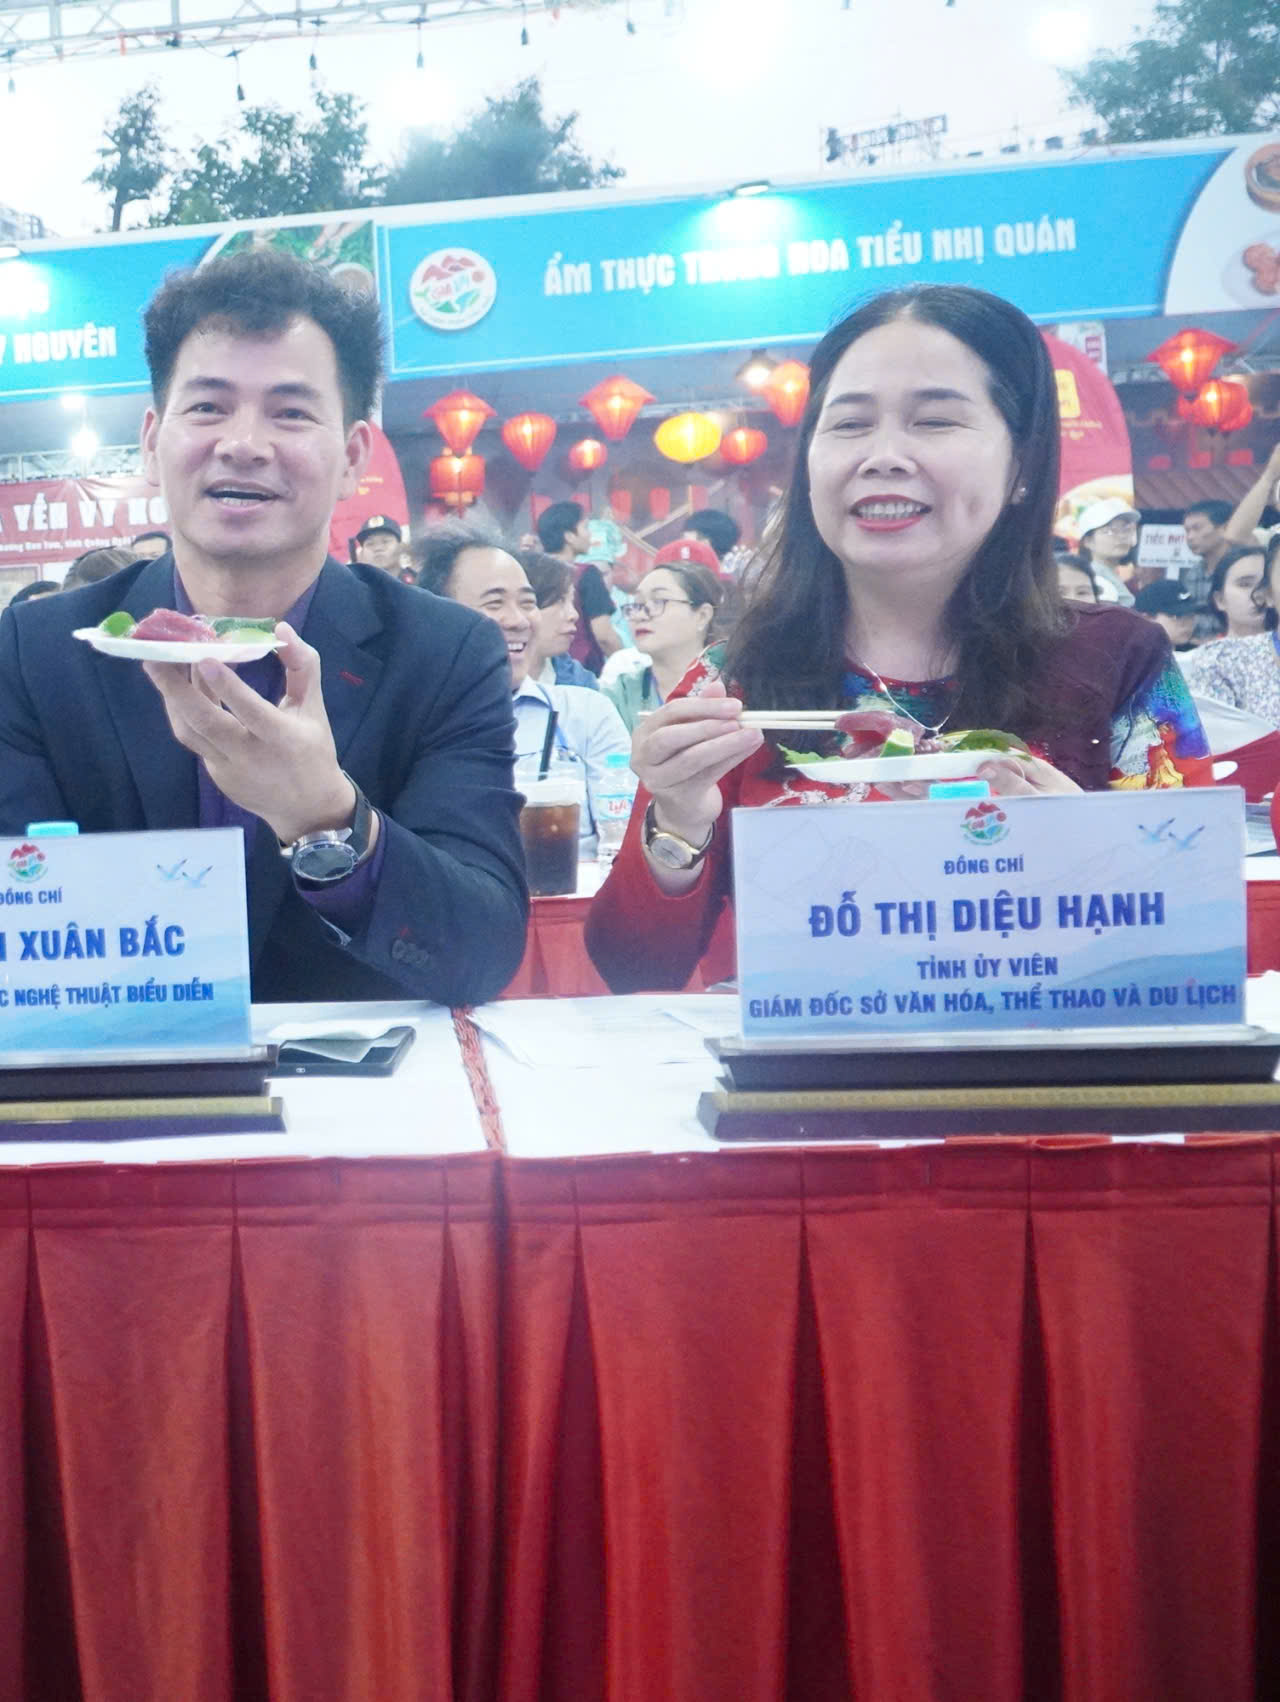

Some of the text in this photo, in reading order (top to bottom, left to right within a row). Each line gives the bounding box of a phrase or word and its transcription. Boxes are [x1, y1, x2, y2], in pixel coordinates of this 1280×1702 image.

[600, 250, 678, 296] THỰC
[857, 219, 922, 269] TIỂU
[931, 226, 985, 265] NHỊ
[12, 321, 117, 363] NGUYÊN
[995, 853, 1024, 873] CHÍ
[38, 887, 62, 904] CHÍ
[808, 890, 1165, 941] ĐỖ THỊ DIỆU HẠNH
[19, 921, 106, 961] XUÂN
[119, 915, 186, 957] BẮC
[917, 951, 1058, 980] TỈNH ỦY VIÊN
[14, 985, 61, 1010] NGHỆ
[65, 983, 120, 1009] THUẬT
[127, 976, 167, 1003] BIỂU
[173, 977, 214, 1002] DIỄN
[749, 982, 1238, 1019] GIÁM ĐỐC SỞ VĂN HÓA, THỂ THAO VÀ DU LỊCH
